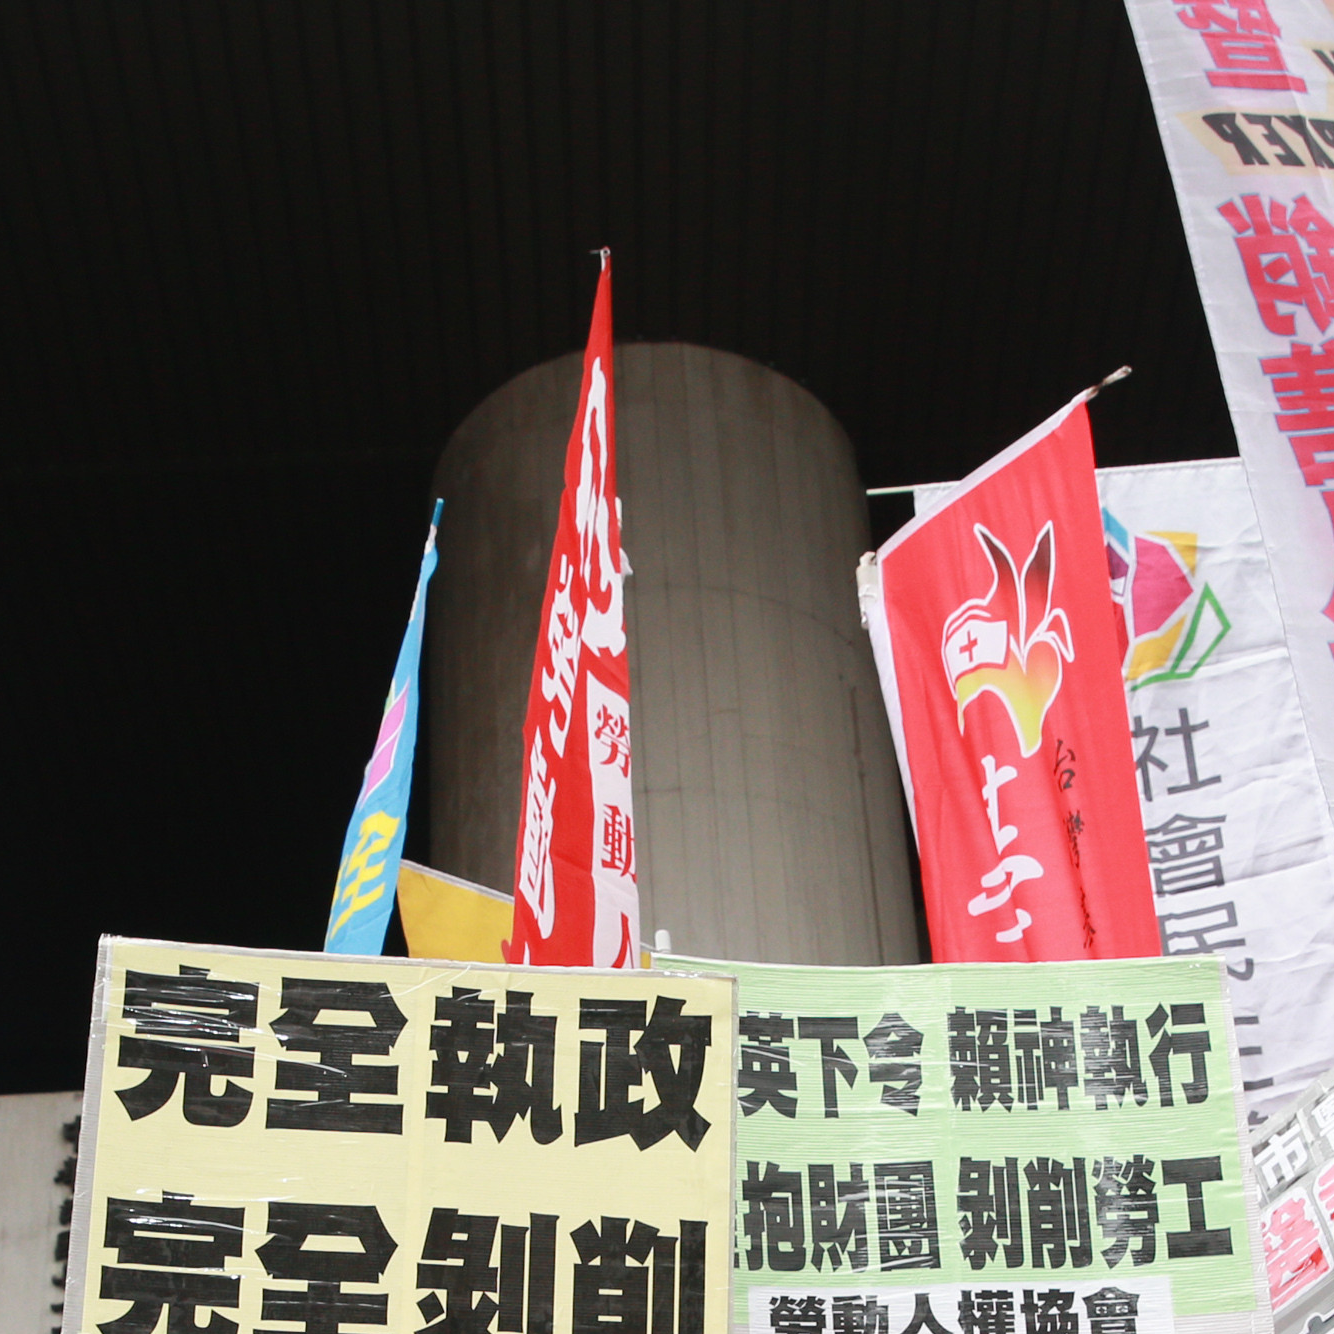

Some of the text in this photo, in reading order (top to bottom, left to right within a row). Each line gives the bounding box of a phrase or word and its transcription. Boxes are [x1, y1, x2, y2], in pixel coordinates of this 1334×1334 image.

[114, 964, 712, 1152] 完全執政
[737, 1002, 1213, 1118] 英下令 賴神執行
[734, 1154, 1234, 1272] 抱財團 剝削勞工
